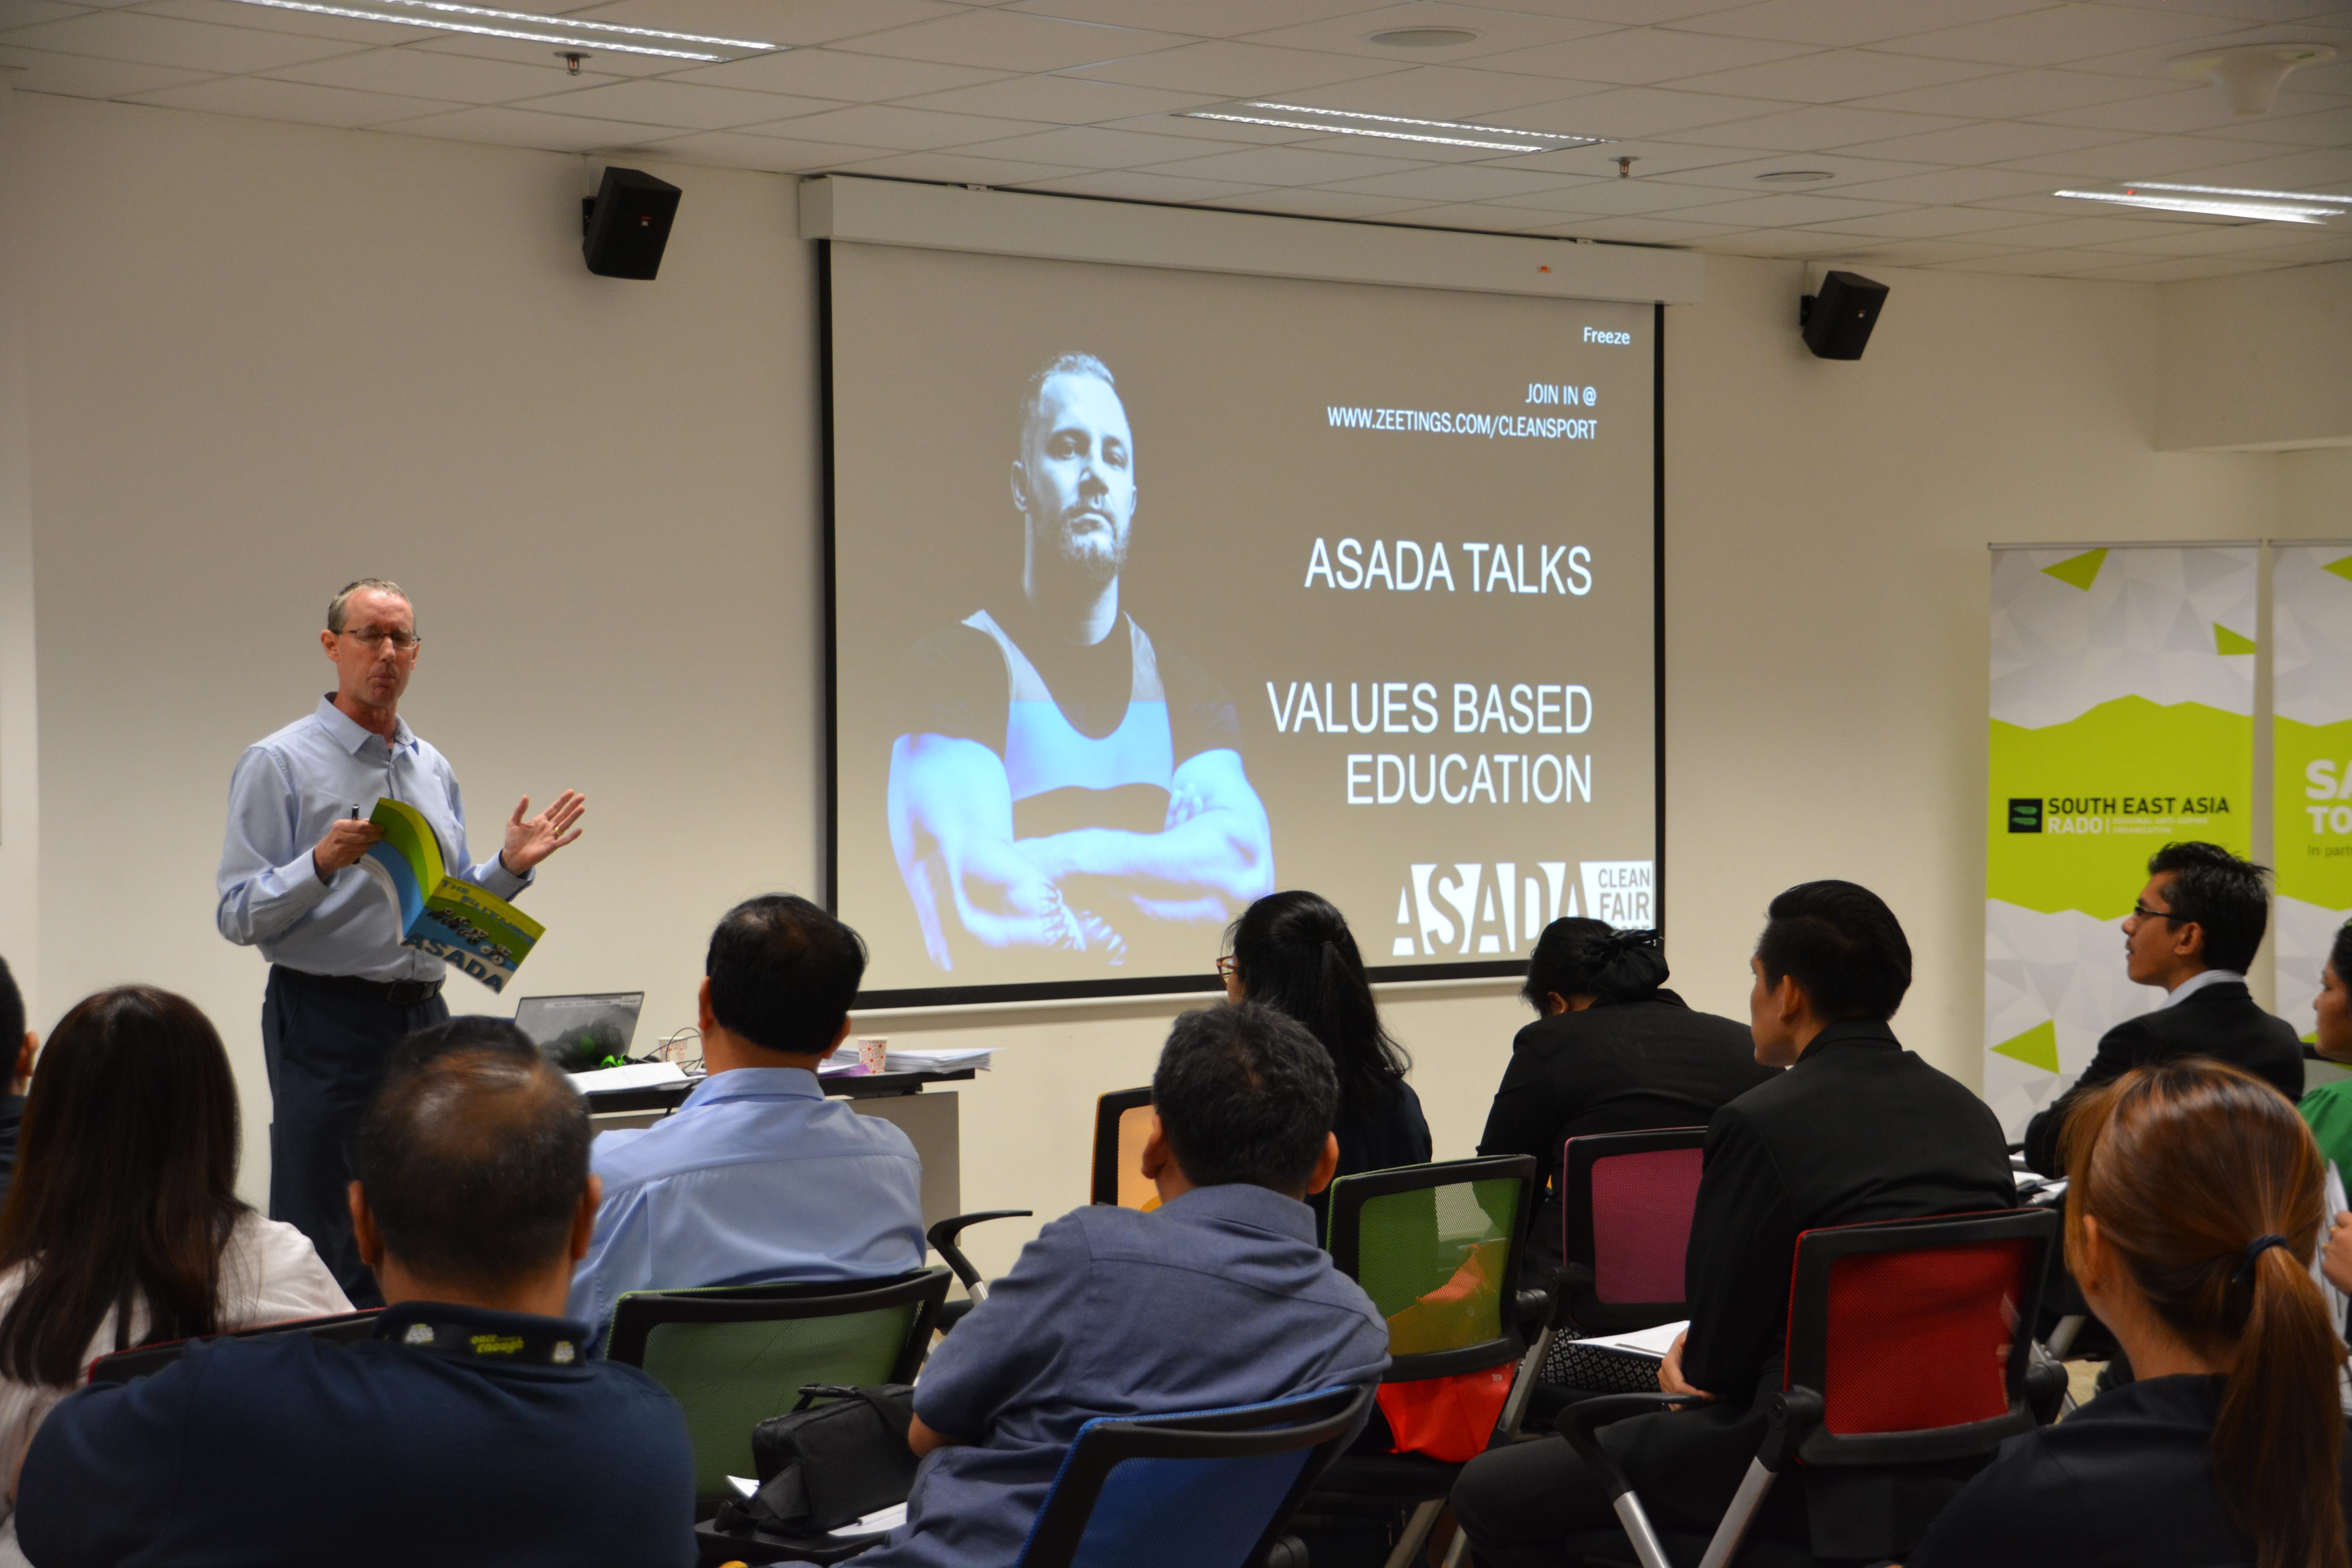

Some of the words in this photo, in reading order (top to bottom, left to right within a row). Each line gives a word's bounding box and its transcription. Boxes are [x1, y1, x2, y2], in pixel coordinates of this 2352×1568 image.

[1583, 327, 1630, 345] Freeze
[1526, 383, 1559, 405] JOIN
[1563, 386, 1579, 405] IN
[1583, 386, 1597, 407] @
[1327, 407, 1597, 439] WWW.ZEETINGS.COM/CLEANSPORT
[1304, 537, 1455, 592] ASADA
[1462, 543, 1592, 595] TALKS
[1266, 681, 1439, 734] VALUES
[1454, 683, 1592, 734] BASED
[1347, 753, 1591, 804] EDUCATION
[2048, 798, 2116, 814] SOUTH
[2123, 797, 2176, 814] EAST
[2181, 797, 2230, 814] ASIA
[2048, 817, 2103, 834] RADO
[442, 879, 470, 895] THE
[1599, 868, 1650, 888] CLEAN
[1390, 862, 1591, 956] ASADA
[1600, 891, 1650, 921] FAIR
[401, 933, 504, 994] ASADA
